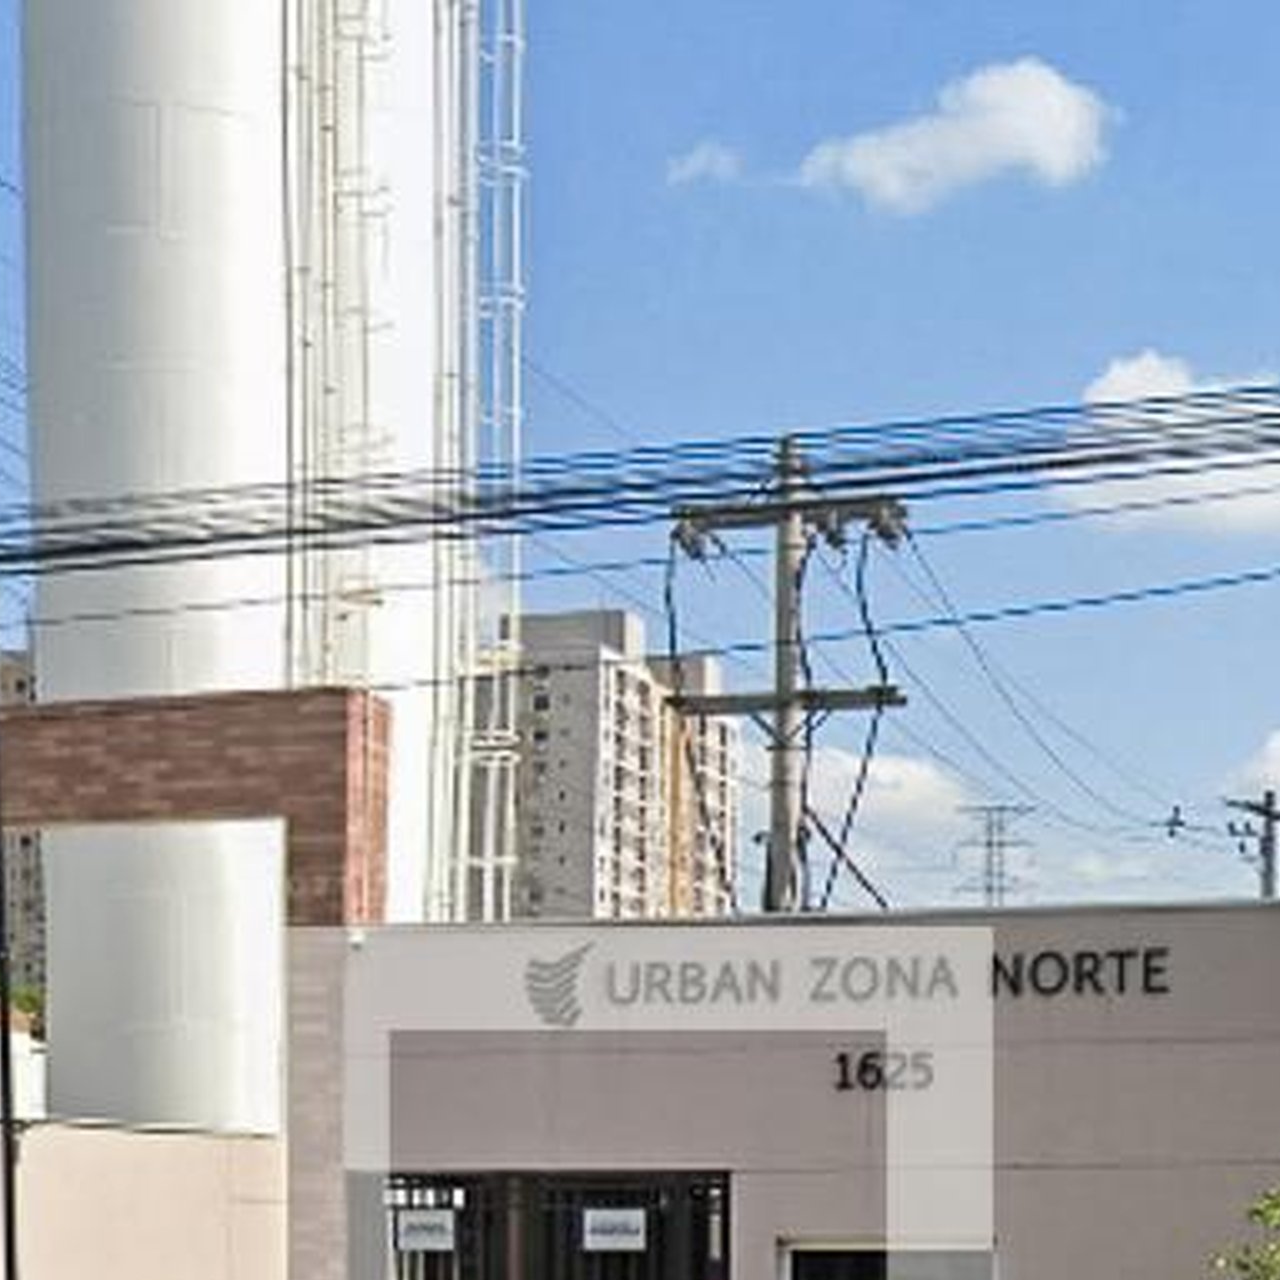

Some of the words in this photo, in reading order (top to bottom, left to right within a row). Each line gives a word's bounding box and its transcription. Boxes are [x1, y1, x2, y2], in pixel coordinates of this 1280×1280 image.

[606, 959, 781, 1006] URBAN
[808, 955, 960, 1001] ZONA
[991, 946, 1171, 999] NORTE
[833, 1051, 934, 1092] 1625
